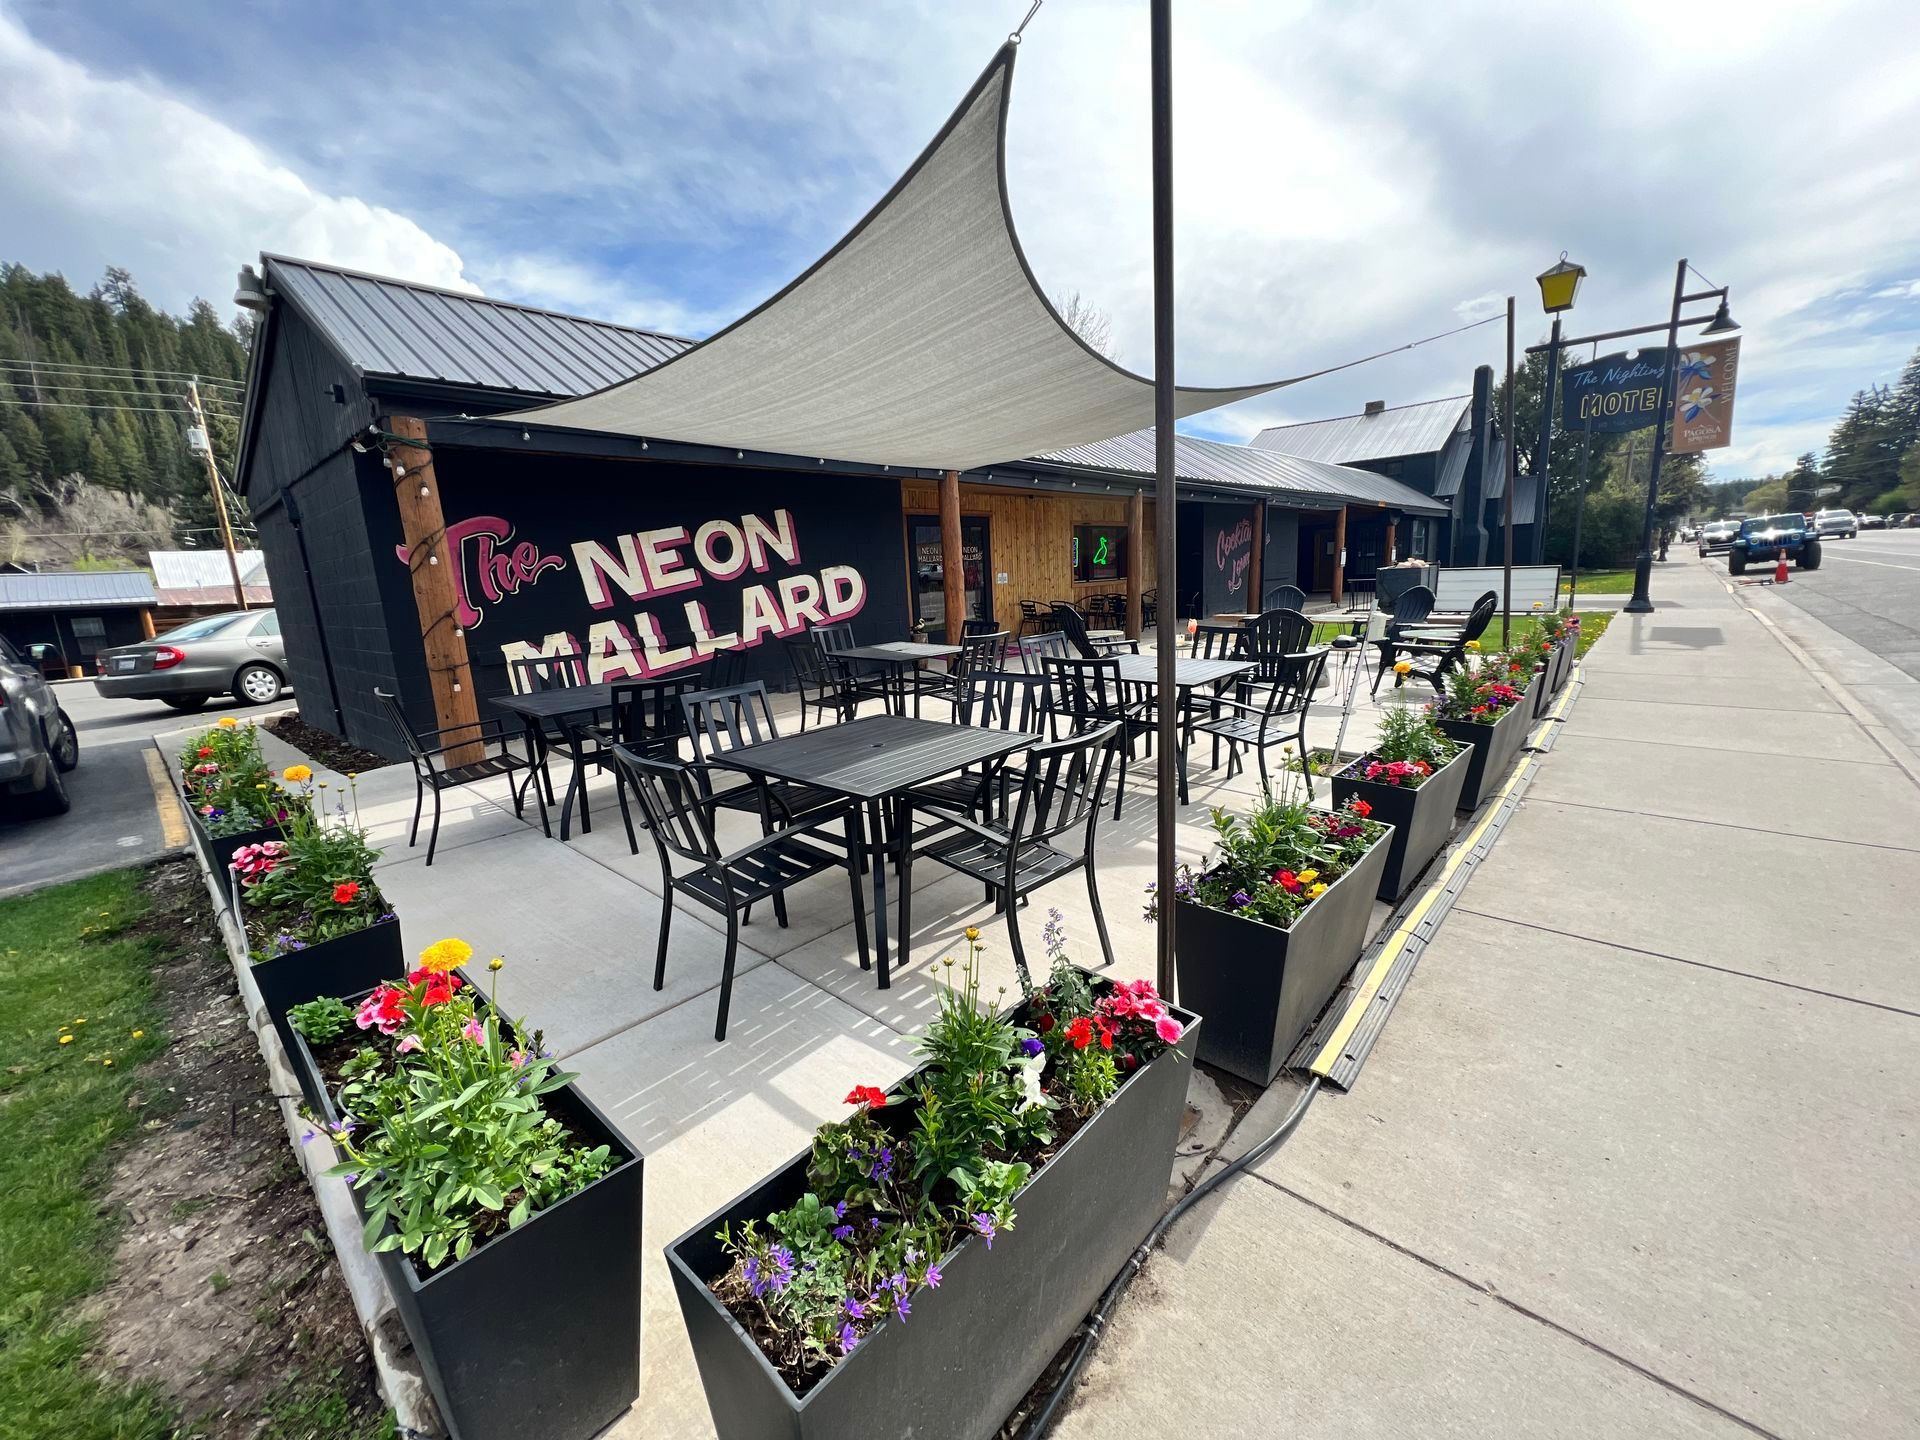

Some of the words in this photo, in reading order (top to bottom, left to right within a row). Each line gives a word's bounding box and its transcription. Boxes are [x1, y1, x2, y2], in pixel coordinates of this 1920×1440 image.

[1574, 370, 1598, 389] The
[1601, 363, 1665, 386] Nighting
[1721, 344, 1737, 405] WELCOME
[921, 547, 939, 555] NEON
[963, 546, 978, 554] NEON
[963, 551, 983, 561] ALLARD
[396, 516, 566, 629] The
[571, 508, 801, 609] NEON
[501, 565, 867, 695] MALLARD
